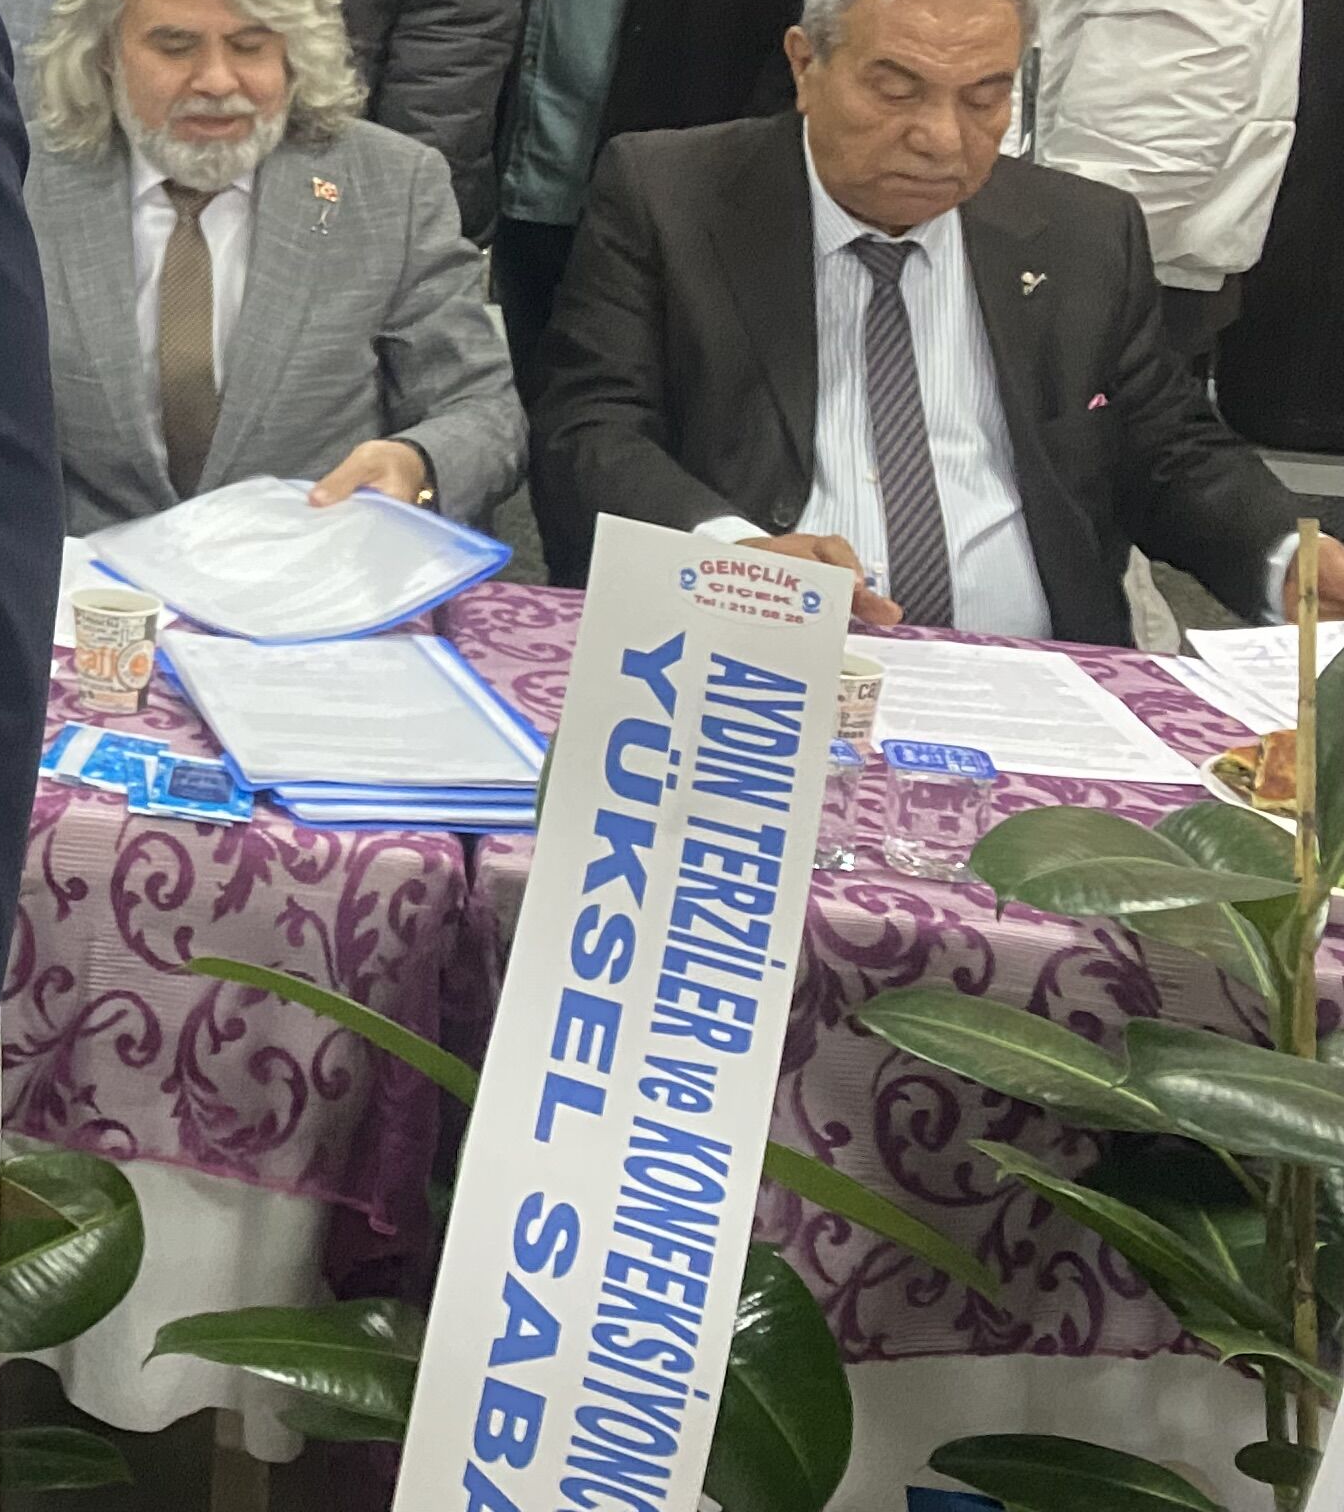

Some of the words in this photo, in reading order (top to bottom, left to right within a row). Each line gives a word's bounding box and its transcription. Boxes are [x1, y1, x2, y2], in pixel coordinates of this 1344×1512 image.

[699, 559, 802, 593] GENÇLİK
[693, 653, 807, 811] AYDIN
[535, 631, 686, 1143] YÜKSEL
[651, 815, 787, 1055] TERZİLER
[639, 1055, 717, 1114] ve
